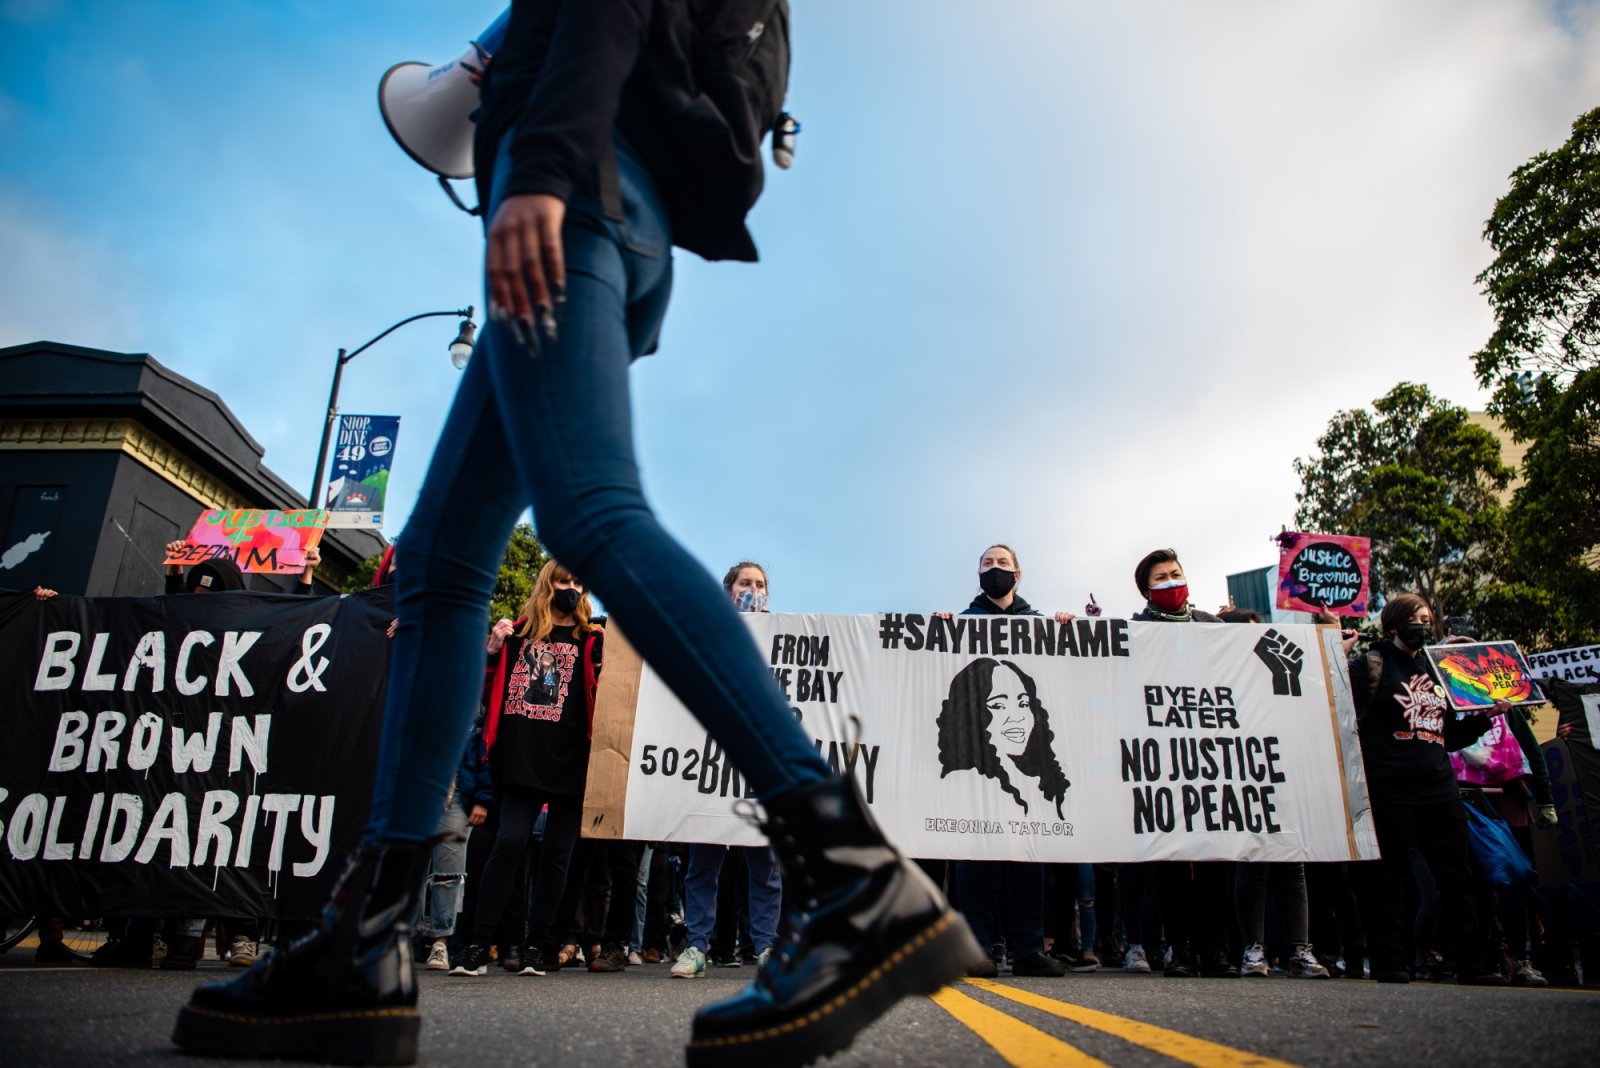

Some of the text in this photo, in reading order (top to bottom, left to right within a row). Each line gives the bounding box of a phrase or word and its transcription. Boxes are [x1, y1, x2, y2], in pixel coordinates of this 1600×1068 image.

[342, 416, 371, 431] SHOP
[339, 430, 368, 446] DINE
[336, 445, 366, 461] 49
[1308, 583, 1358, 606] Taylor
[879, 613, 1130, 657] #SAYHERNAME
[34, 623, 332, 697] BLACK &
[771, 634, 830, 667] FROM
[1528, 648, 1600, 669] PROTECT
[1484, 664, 1521, 674] JUSTICE
[1494, 673, 1512, 681] NO
[796, 669, 844, 703] BAY
[1164, 686, 1234, 707] YEAR
[504, 701, 563, 722] MATTERS
[1146, 705, 1240, 729] LATER
[48, 710, 272, 777] BROWN
[1120, 736, 1286, 783] NO JUSTICE
[1133, 784, 1281, 834] NO PEACE
[925, 818, 1074, 836] BREONNA TAYLOR
